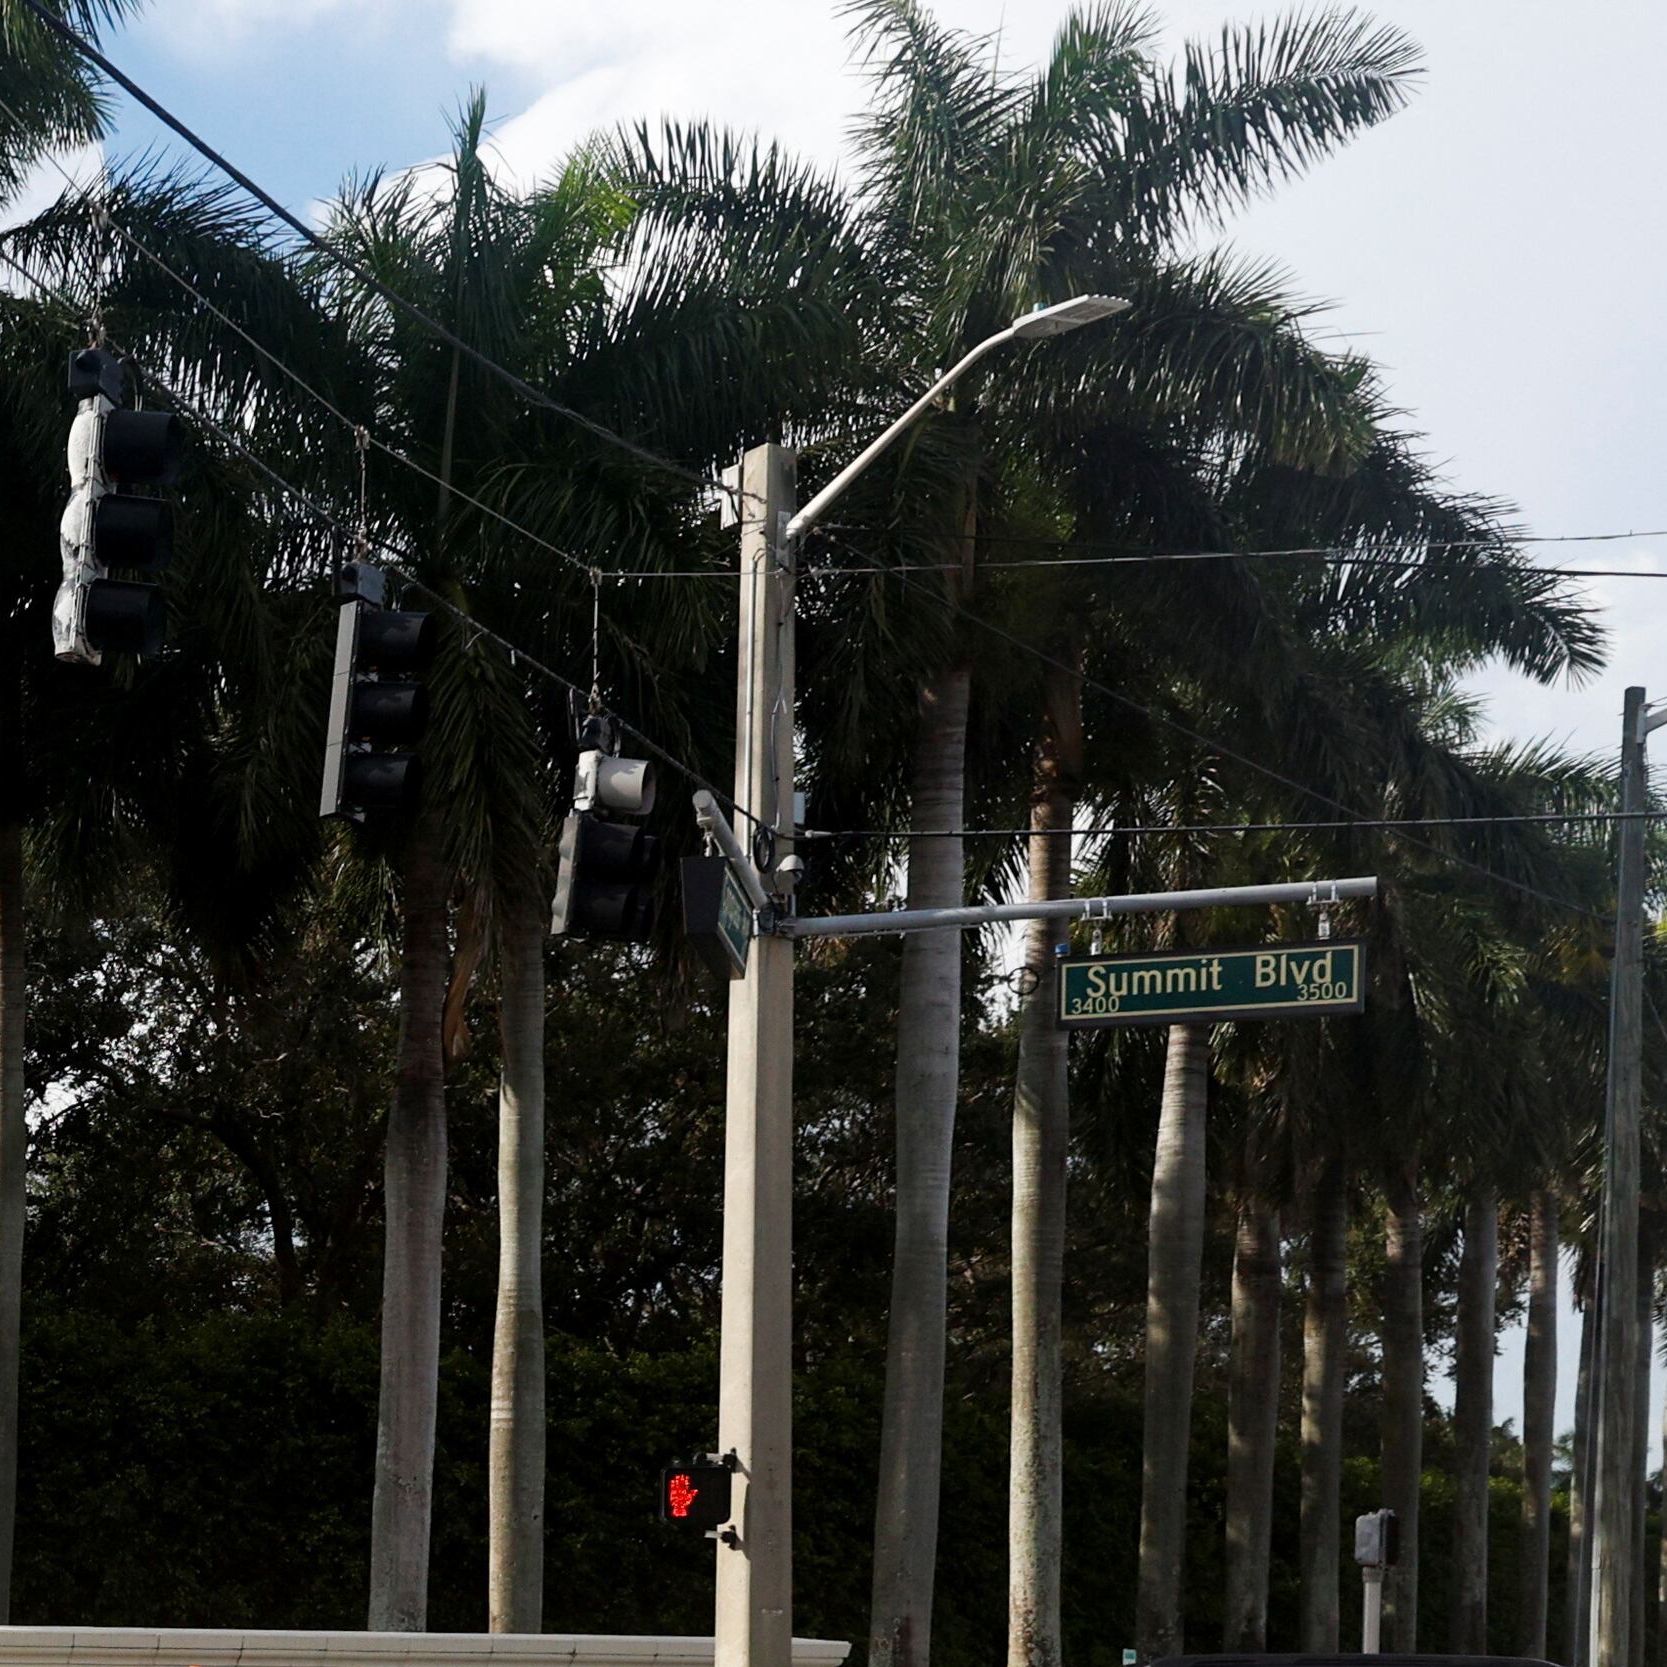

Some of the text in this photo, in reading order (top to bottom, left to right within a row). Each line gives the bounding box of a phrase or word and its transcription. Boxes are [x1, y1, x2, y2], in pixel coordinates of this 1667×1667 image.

[1086, 950, 1333, 999] Summit Blvd
[1297, 981, 1347, 1001] 3500
[1071, 995, 1120, 1015] 3400
